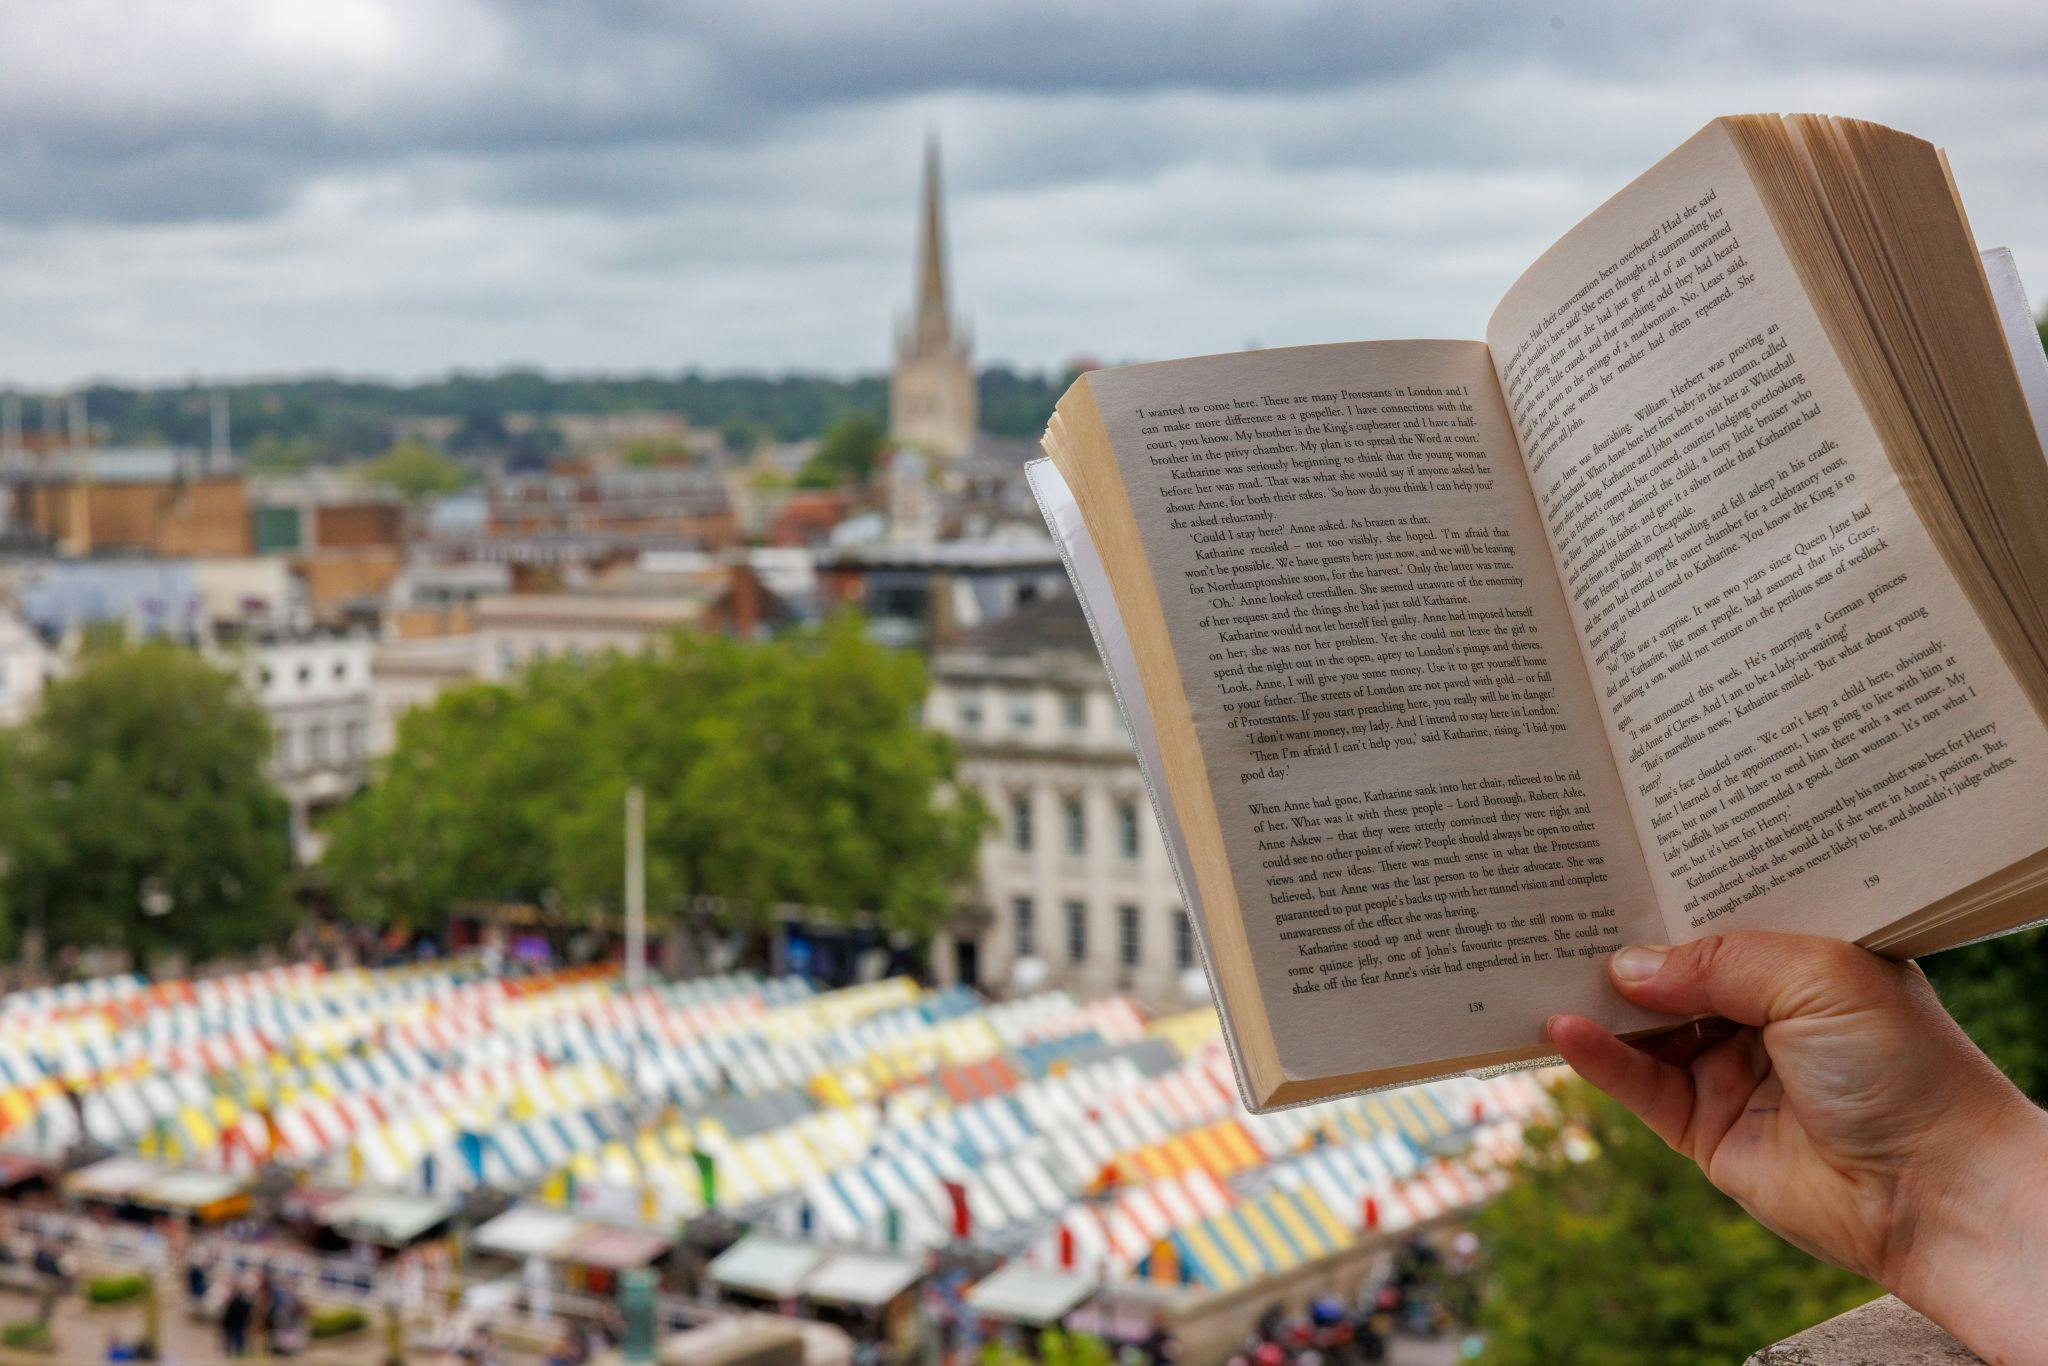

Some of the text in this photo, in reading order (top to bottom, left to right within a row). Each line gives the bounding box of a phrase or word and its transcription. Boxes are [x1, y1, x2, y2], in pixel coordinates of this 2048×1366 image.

[1529, 187, 1717, 343] Had their conversation been overheard? Had she said
[1147, 403, 1186, 418] wanted
[1188, 406, 1200, 414] to
[1203, 402, 1231, 413] come
[1232, 398, 1259, 409] here.
[1259, 395, 1290, 407] There
[1292, 395, 1309, 404] are
[1311, 393, 1338, 404] many
[1340, 389, 1393, 400] Protestants
[1394, 387, 1405, 397] in
[1406, 385, 1444, 397] London
[1445, 385, 1463, 396] and
[1463, 386, 1469, 396] I
[1159, 463, 1491, 498] before her was mad. That was what she would say if anyone asked her
[1582, 440, 1839, 611] When Henry finally stopped bawling and fell asleep in his cradle,
[1189, 560, 1514, 595] for Northamptonshire soon, for the harvest.' Only the latter was true.
[1621, 685, 1646, 705] having
[1644, 681, 1651, 690] a
[1650, 672, 1667, 686] son,
[1667, 650, 1694, 674] would
[1694, 644, 1711, 659] not
[1710, 624, 1744, 648] venture
[1745, 616, 1759, 628] on
[1759, 605, 1776, 619] the
[1776, 583, 1814, 613] perilous
[1814, 571, 1834, 588] seas
[1835, 561, 1847, 575] of
[1847, 539, 1889, 567] wedlock
[1217, 655, 1548, 695] 'Look, Anne, I will give you some money. Use it to get yourself home
[1638, 721, 1652, 735] was
[1653, 691, 1696, 725] announced
[1697, 682, 1715, 698] this
[1716, 666, 1743, 686] week.
[1743, 651, 1767, 670] He's
[1769, 628, 1813, 657] marrying
[1814, 622, 1823, 631] a
[1823, 598, 1865, 624] German
[1867, 573, 1908, 604] princess
[1650, 656, 1957, 830] Before I learned of the appointment, I was going to live with him at
[1240, 764, 1290, 785] good day.'
[1247, 769, 1582, 816] When Anne had gone, Katharine sank into her chair, relieved to be rid
[1690, 757, 2017, 929] she thought sadly, she was never likely to be, and shouldn't judge others.
[1863, 874, 1880, 889] 159
[1291, 980, 1321, 995] shake
[1322, 976, 1338, 991] off
[1340, 975, 1358, 988] the
[1360, 972, 1380, 986] fear
[1383, 966, 1418, 982] Anne's
[1419, 963, 1442, 976] visit
[1443, 959, 1464, 974] had
[1465, 952, 1520, 973] engendered
[1520, 952, 1532, 964] in
[1533, 949, 1553, 962] her.
[1553, 946, 1577, 959] That
[1467, 1001, 1485, 1013] 158
